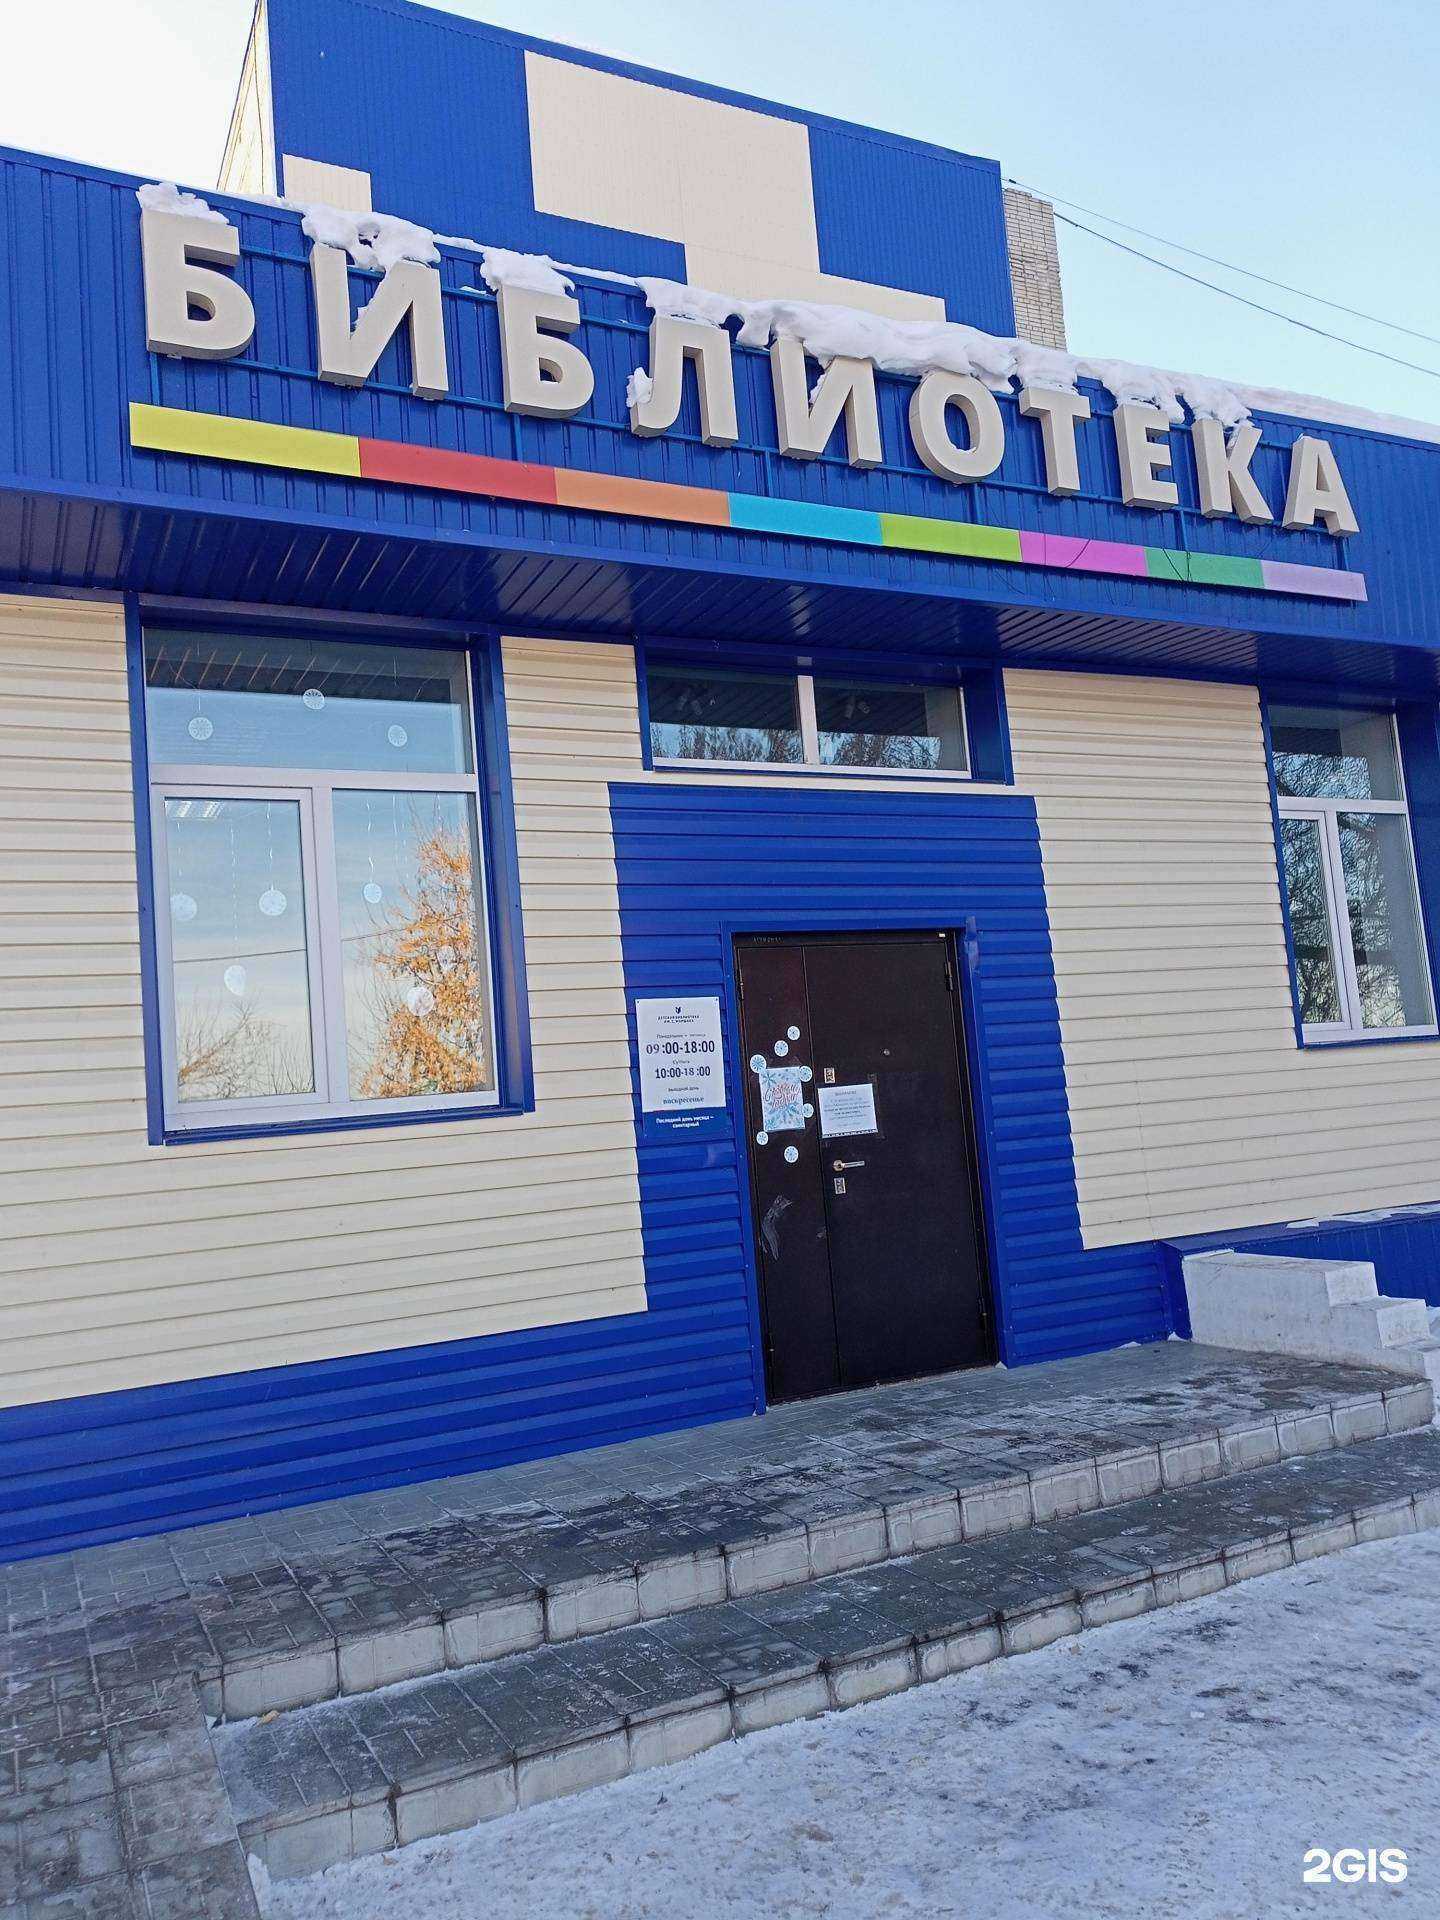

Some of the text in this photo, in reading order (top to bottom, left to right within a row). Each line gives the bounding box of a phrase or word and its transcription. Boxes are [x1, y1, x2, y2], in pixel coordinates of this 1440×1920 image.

[139, 207, 1360, 537] БИБЛИОТЕКА
[645, 1040, 715, 1055] 09:00-18:00
[655, 1066, 711, 1079] 10:00-18:00
